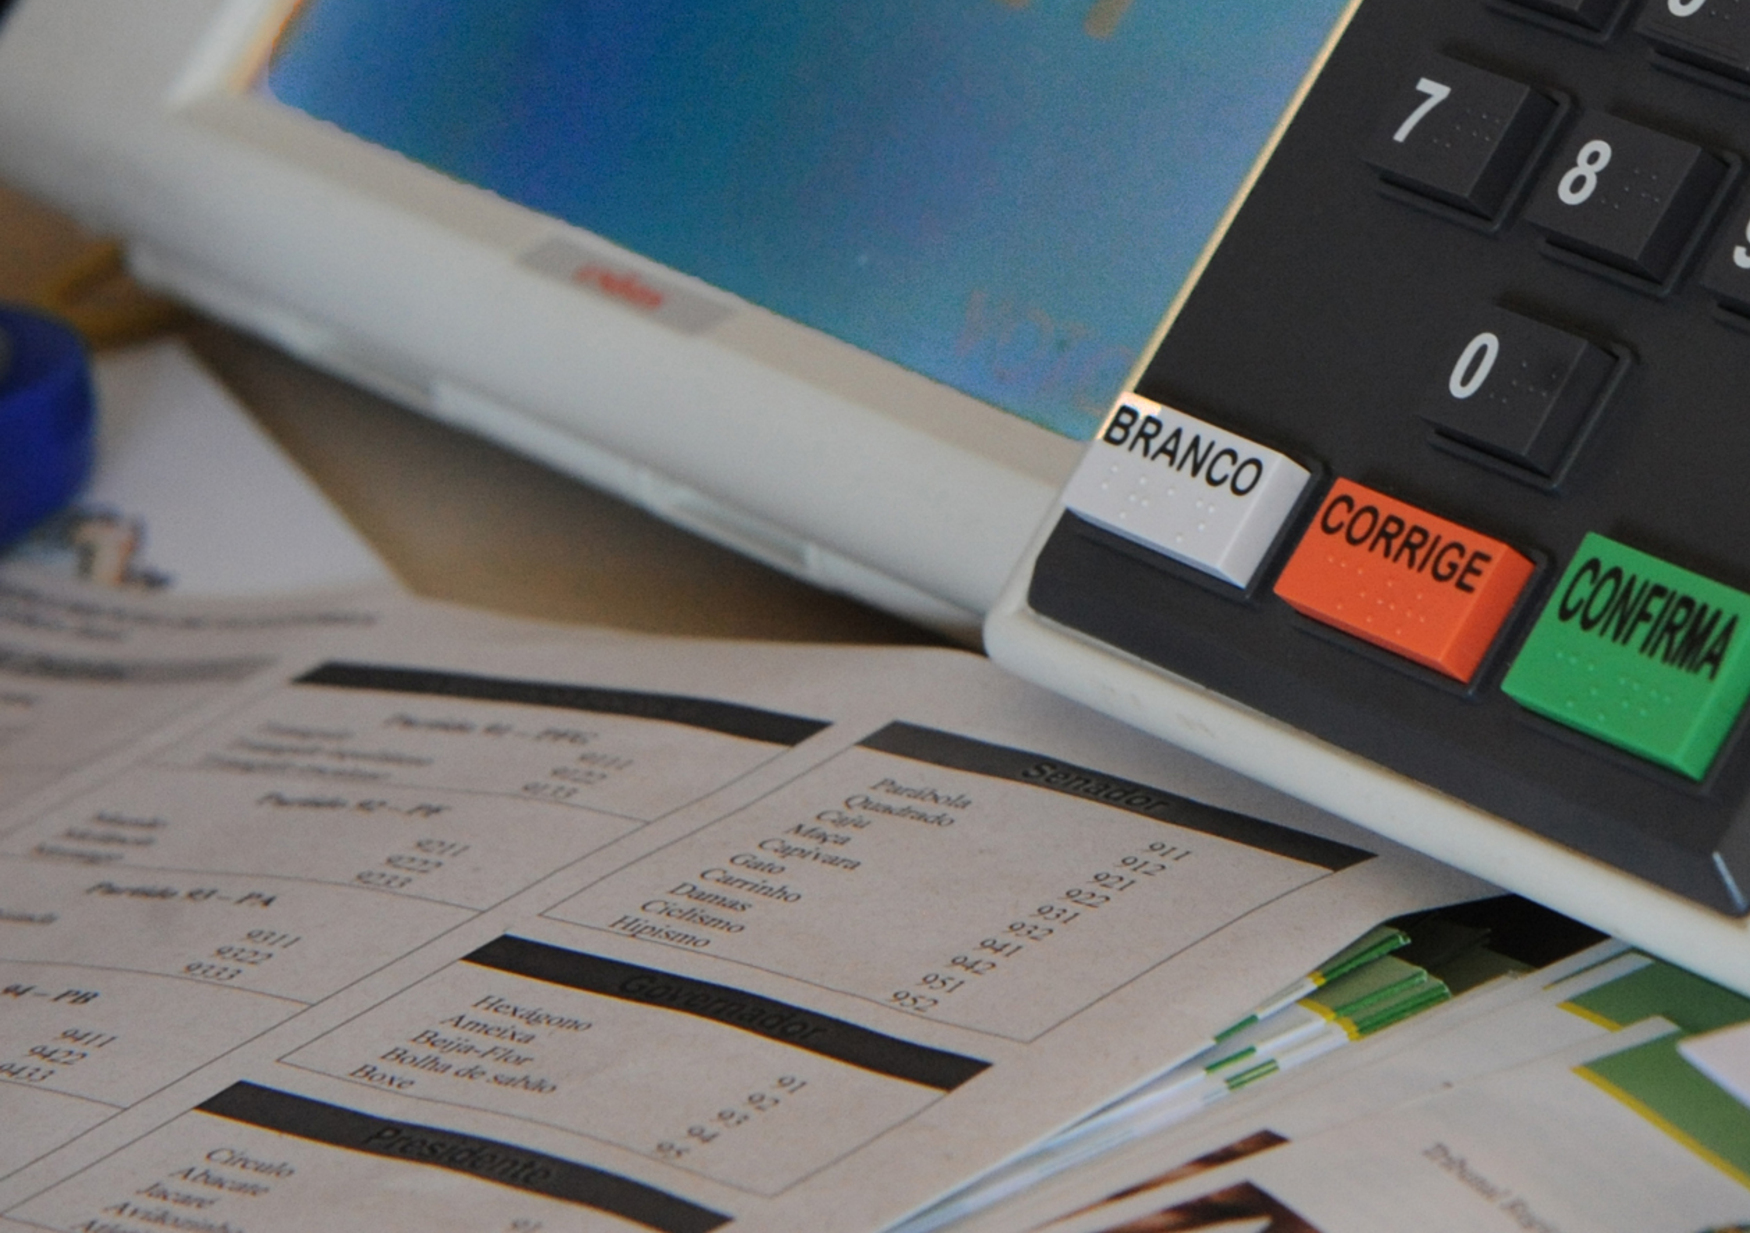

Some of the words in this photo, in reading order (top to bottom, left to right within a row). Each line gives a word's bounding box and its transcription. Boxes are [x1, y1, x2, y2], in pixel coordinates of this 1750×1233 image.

[1392, 77, 1450, 143] 7
[1556, 140, 1612, 206] 8
[1448, 332, 1500, 399] 0
[1103, 405, 1263, 497] BRANCO
[1319, 494, 1493, 595] CORRIGE
[1557, 557, 1738, 682] CONFIRMA
[869, 777, 972, 810] Parábola
[1021, 760, 1170, 810] Senador
[816, 809, 872, 830] Caju
[844, 794, 956, 828] Quadrado
[729, 852, 786, 875] Gato
[757, 837, 862, 871] Capivara
[1113, 855, 1167, 877] 912
[1144, 841, 1193, 862] 911
[667, 882, 753, 913] Damas
[700, 868, 802, 903] Carrinho
[1086, 872, 1136, 892] 921
[1058, 888, 1111, 909] 922
[640, 899, 746, 934] Ciclismo
[1029, 905, 1080, 925] 931
[243, 928, 303, 949] 9311
[608, 914, 711, 949] Hipismo
[1003, 921, 1054, 942] 932
[972, 938, 1024, 958] 941
[945, 955, 997, 976] 942
[51, 988, 100, 1005] PB
[915, 972, 965, 994] 951
[471, 994, 593, 1032] Hexágono
[619, 974, 828, 1040] Governador
[885, 990, 939, 1013] 952
[54, 1028, 118, 1049] 9411
[439, 1013, 537, 1045] Ameixa
[24, 1044, 88, 1066] 9422
[379, 1046, 453, 1075] Bolha
[453, 1063, 487, 1081] de
[409, 1029, 536, 1068] Beija-Flor
[348, 1063, 416, 1090] Boxe
[204, 1146, 296, 1179] Círculo
[361, 1125, 551, 1183] Presidente
